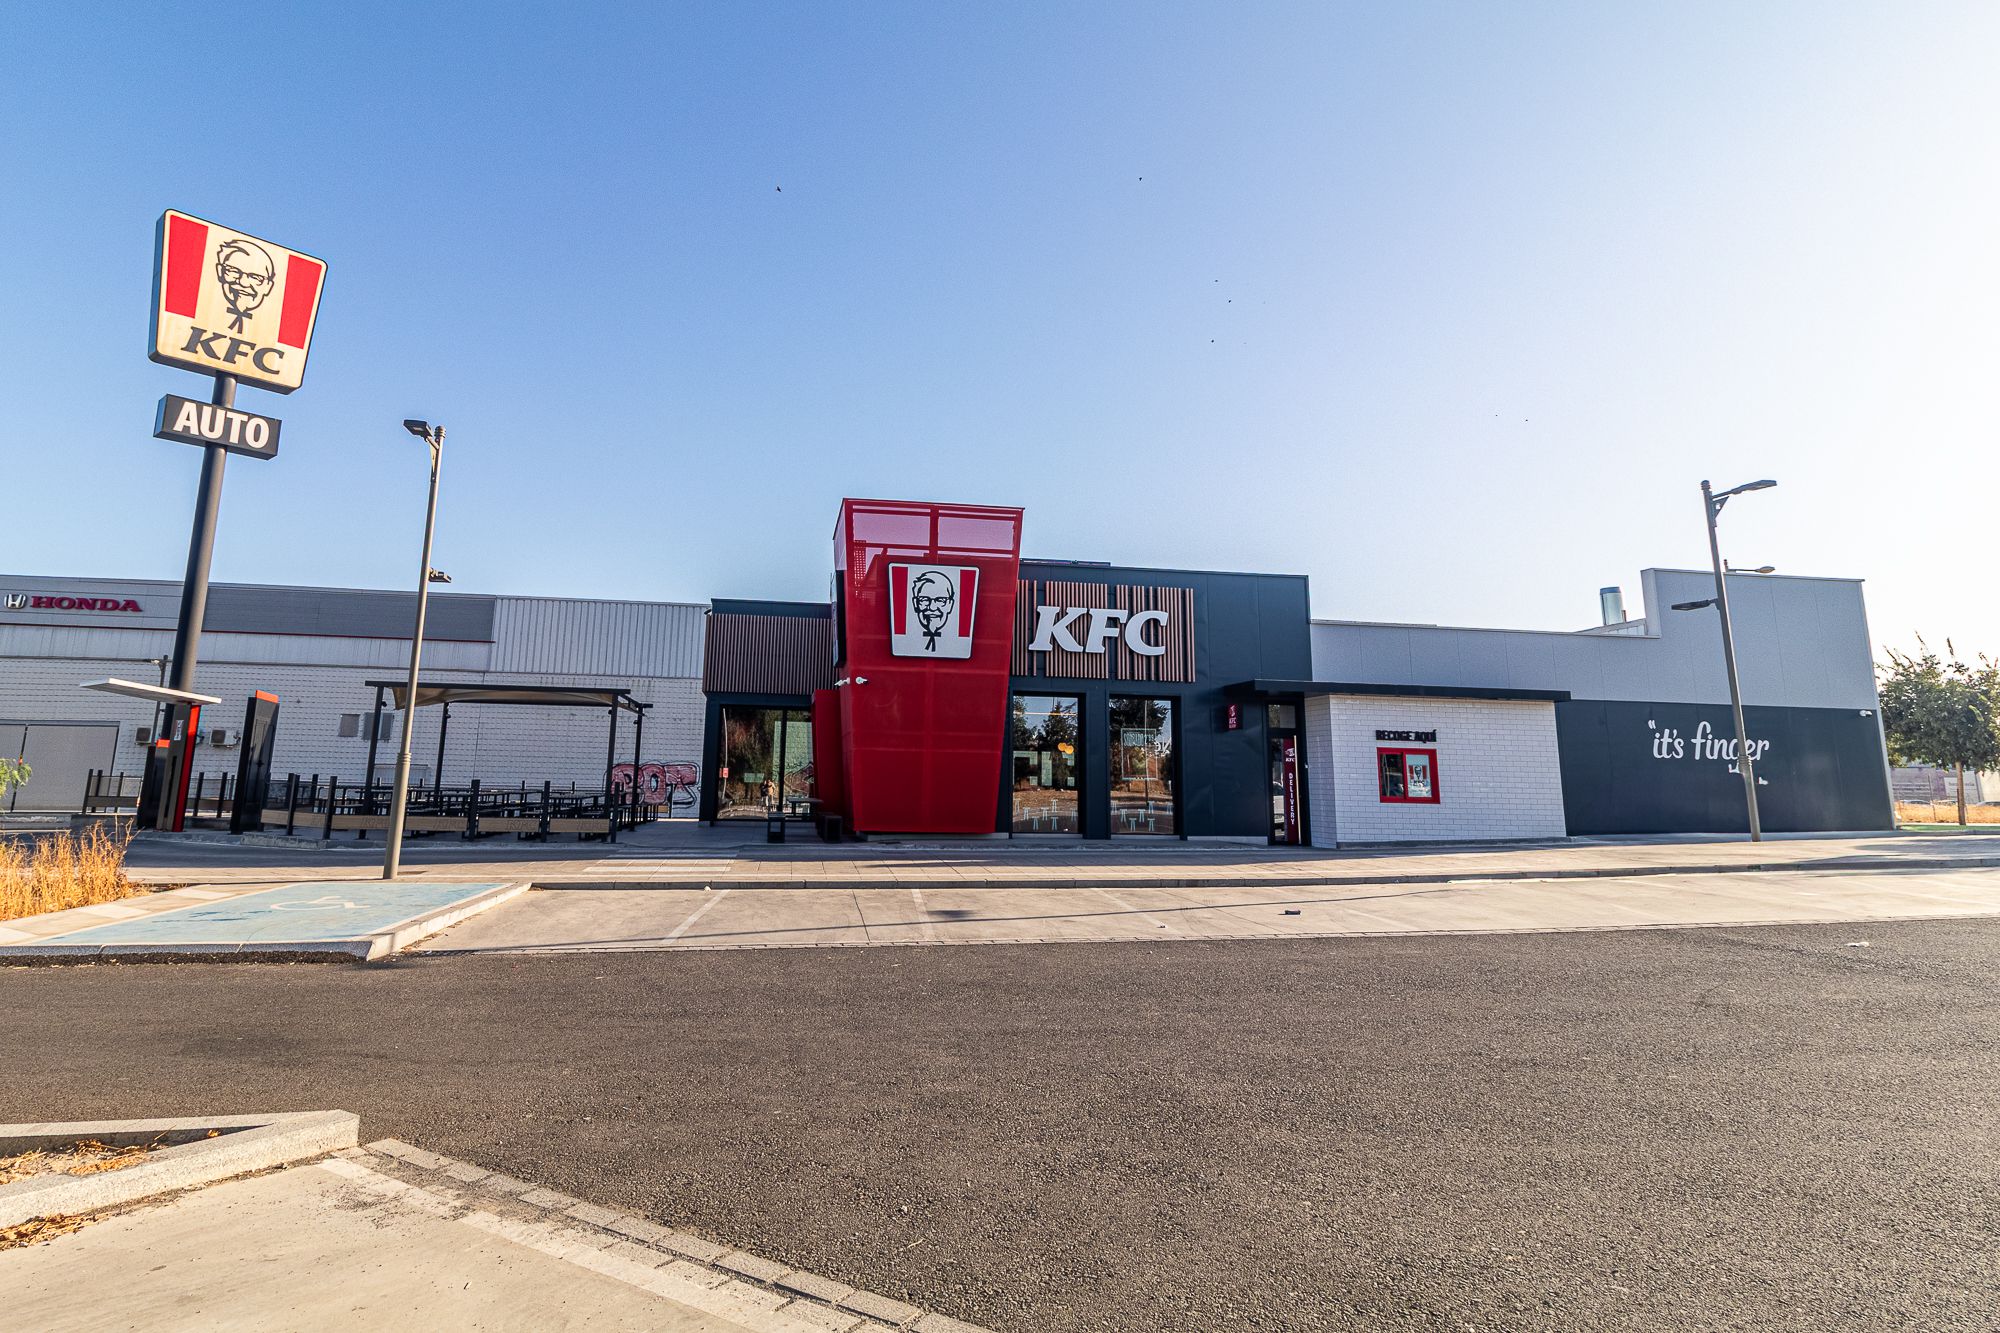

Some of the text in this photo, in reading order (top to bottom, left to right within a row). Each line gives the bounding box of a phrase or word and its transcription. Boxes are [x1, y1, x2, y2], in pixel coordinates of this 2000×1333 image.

[181, 326, 285, 375] KFC
[173, 402, 270, 449] AUTO
[30, 595, 143, 612] HONDA
[1028, 605, 1169, 656] KFC
